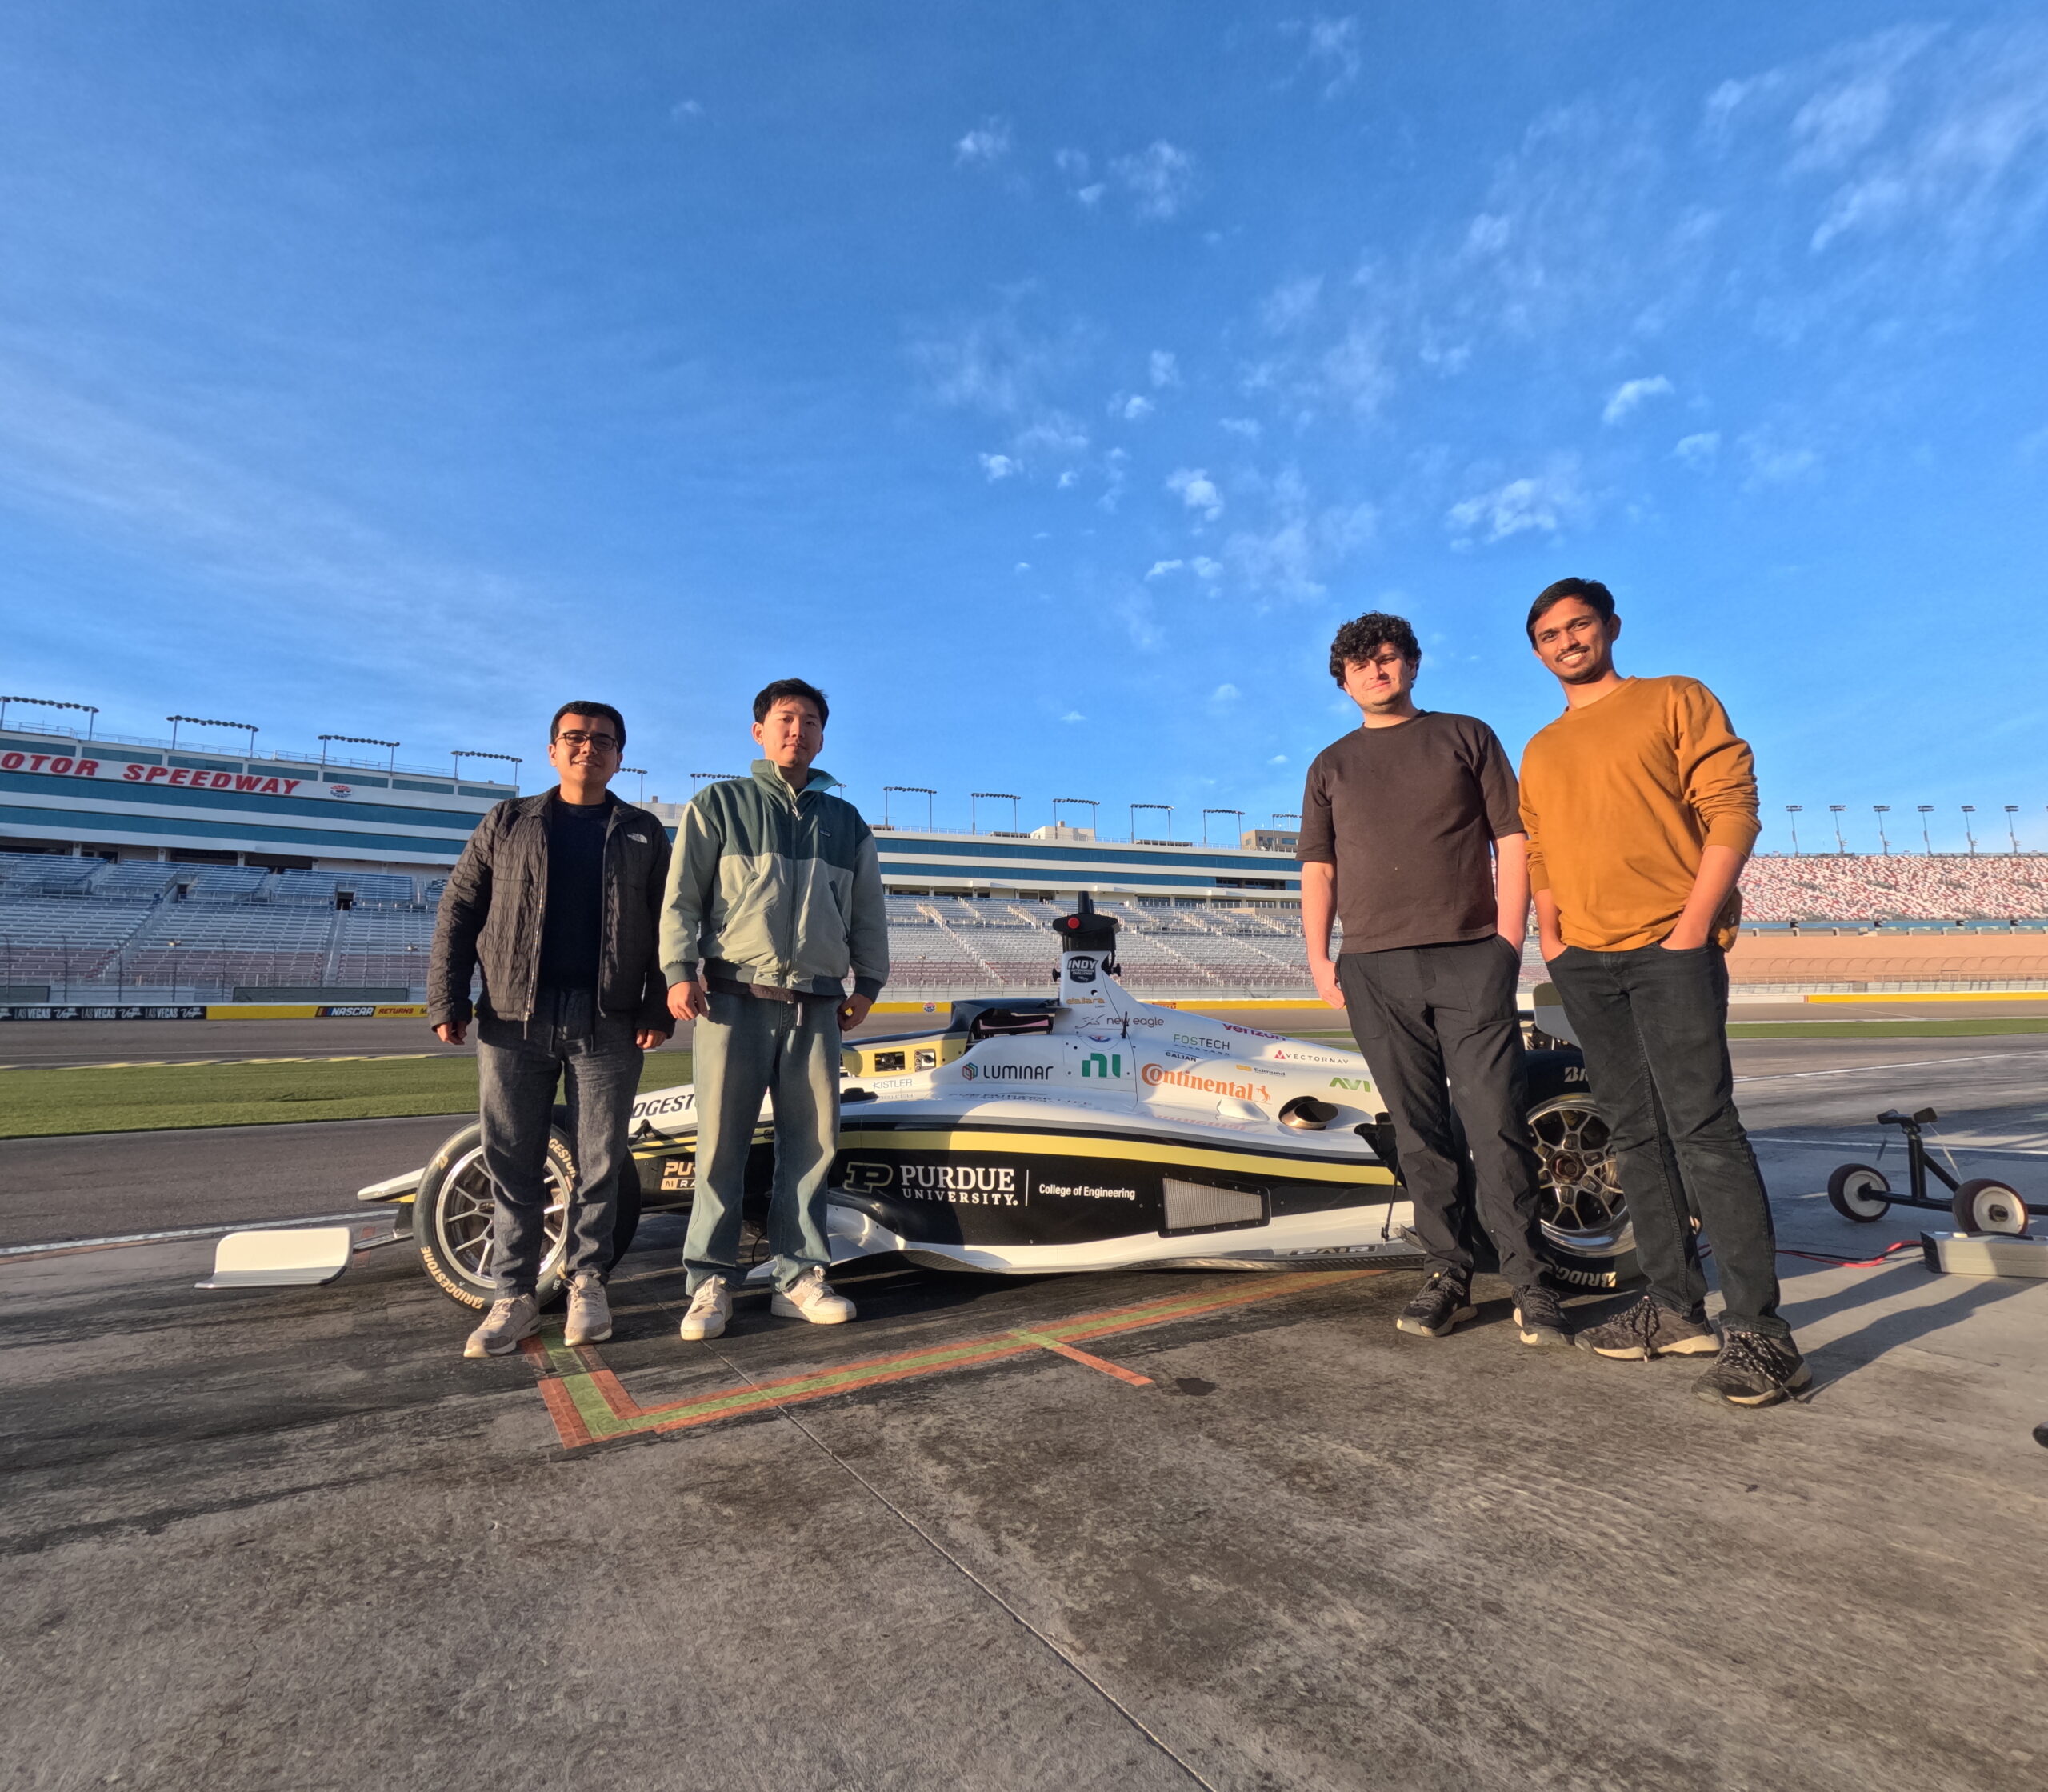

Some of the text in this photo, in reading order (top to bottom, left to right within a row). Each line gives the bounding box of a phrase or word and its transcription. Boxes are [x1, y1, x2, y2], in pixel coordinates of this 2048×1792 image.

[123, 764, 301, 794] SPEEDWAY
[1068, 960, 1097, 969] INDY
[27, 1008, 51, 1019] VEGAS
[94, 1008, 116, 1018] VEGAS
[157, 1008, 178, 1018] VEGAS
[330, 1007, 374, 1016] NASCAR
[1133, 1017, 1165, 1028] eagle
[1222, 1023, 1286, 1041] verizon
[1174, 1034, 1230, 1050] FOSTECH
[1165, 1052, 1197, 1062] CALIAN
[1286, 1053, 1350, 1064] VECTORNAV
[873, 1078, 913, 1089] KISTLER
[1141, 1063, 1254, 1101] Continental
[900, 1165, 1015, 1191] PURDUE
[1039, 1184, 1135, 1200] College of Engineering
[1297, 1246, 1369, 1255] PAIR
[420, 1246, 486, 1310] BRIDGESTONE
